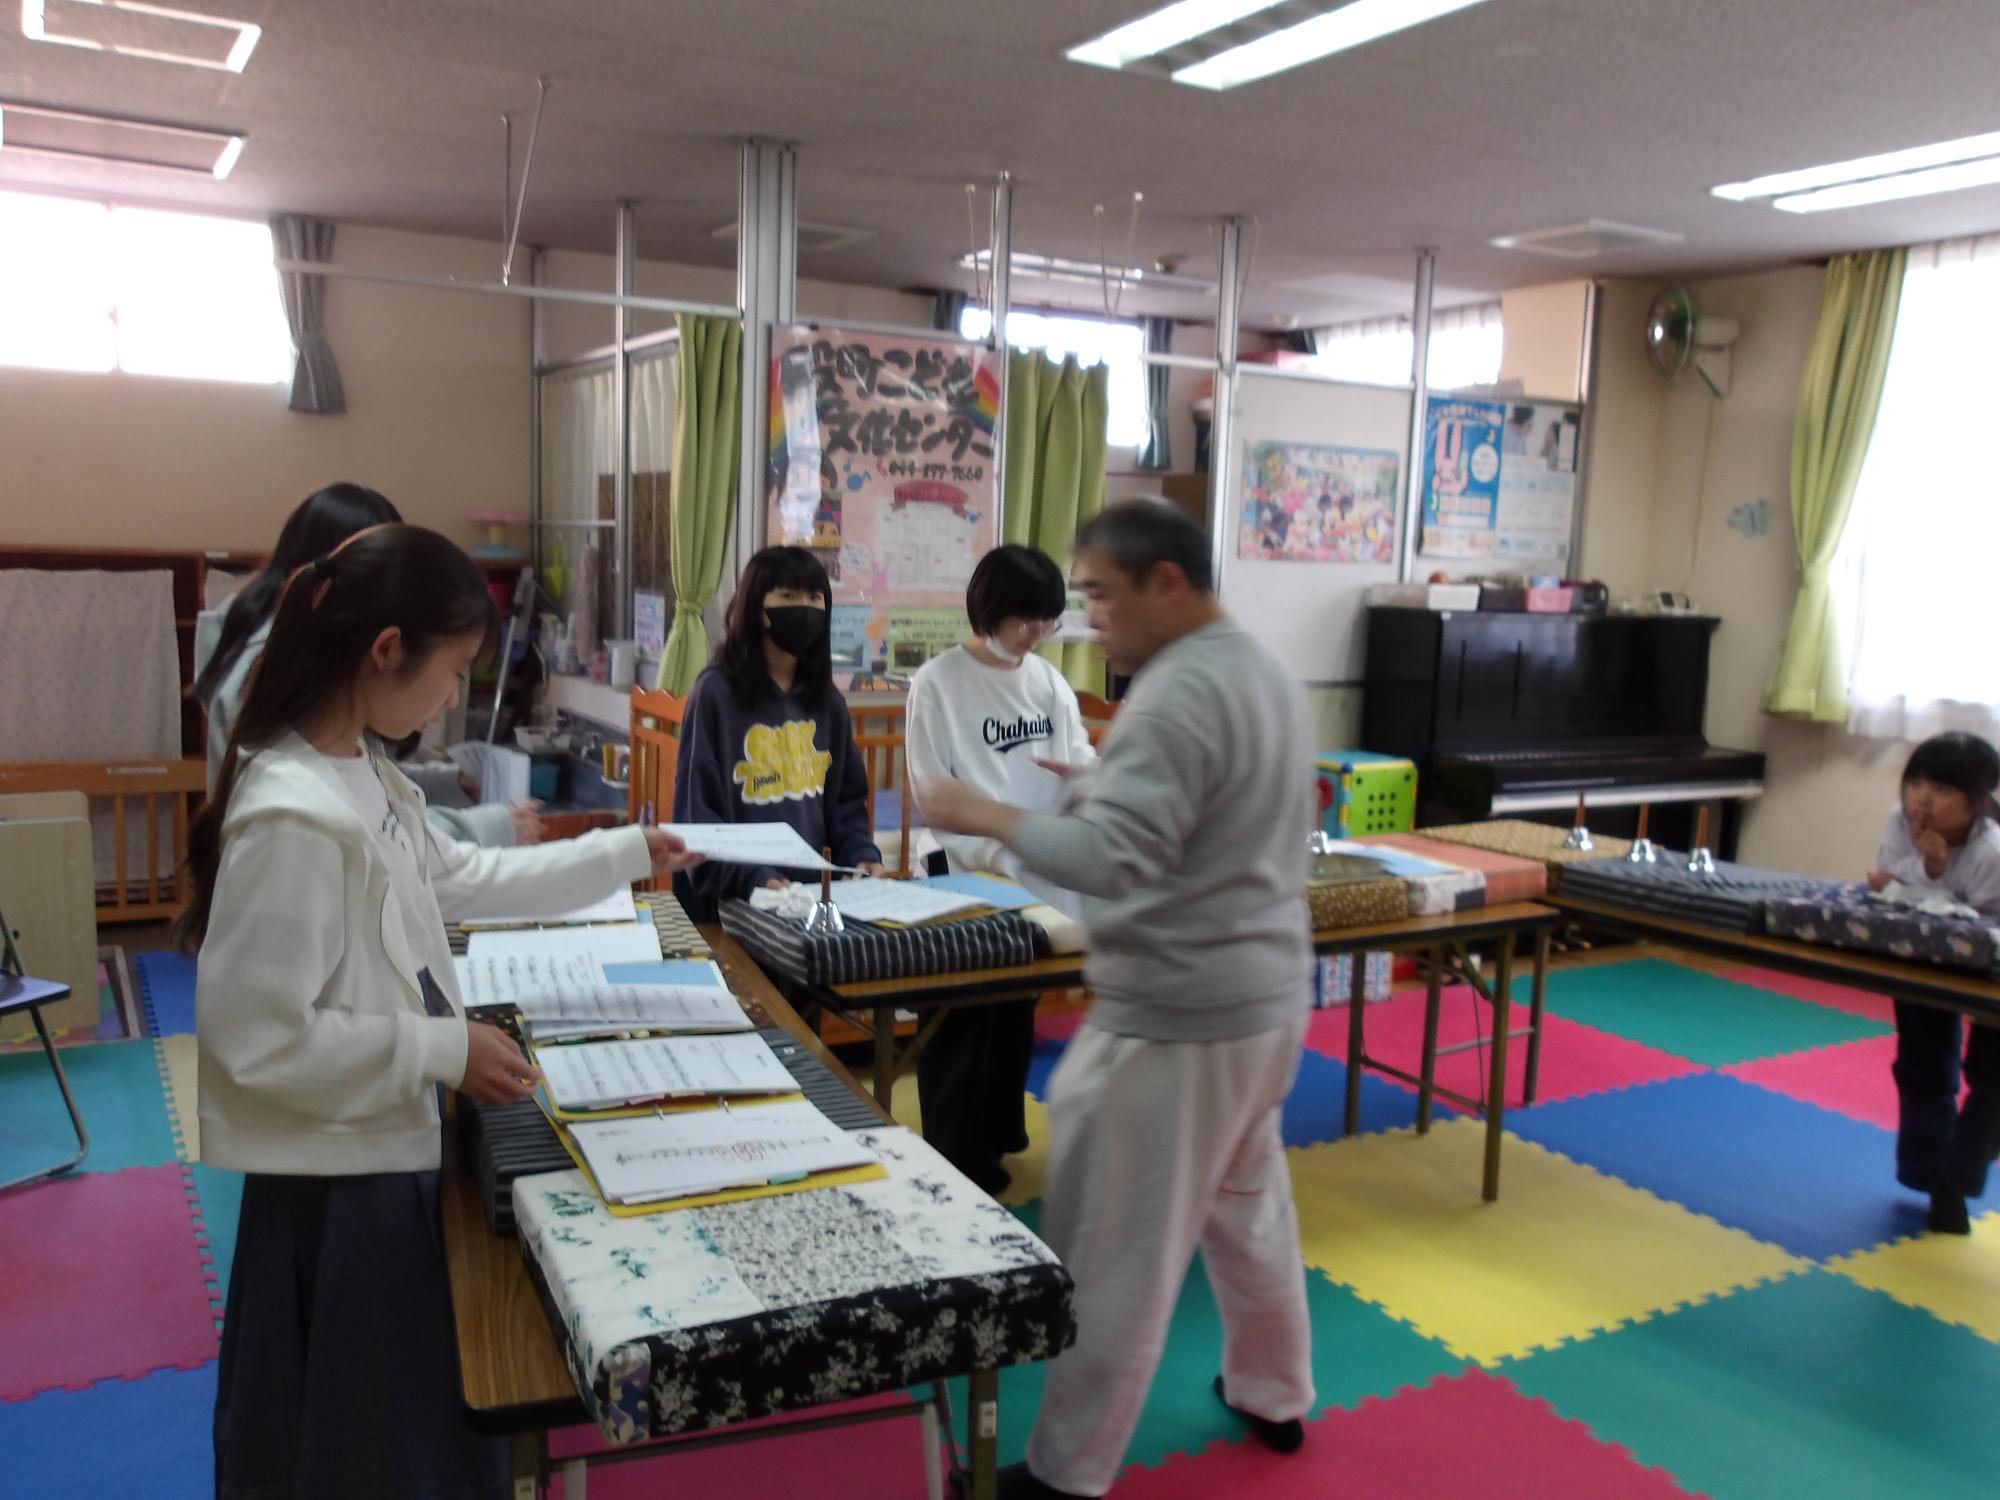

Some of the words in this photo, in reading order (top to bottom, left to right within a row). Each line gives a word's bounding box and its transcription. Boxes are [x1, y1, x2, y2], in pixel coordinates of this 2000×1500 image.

[821, 406, 994, 461] 文化センター
